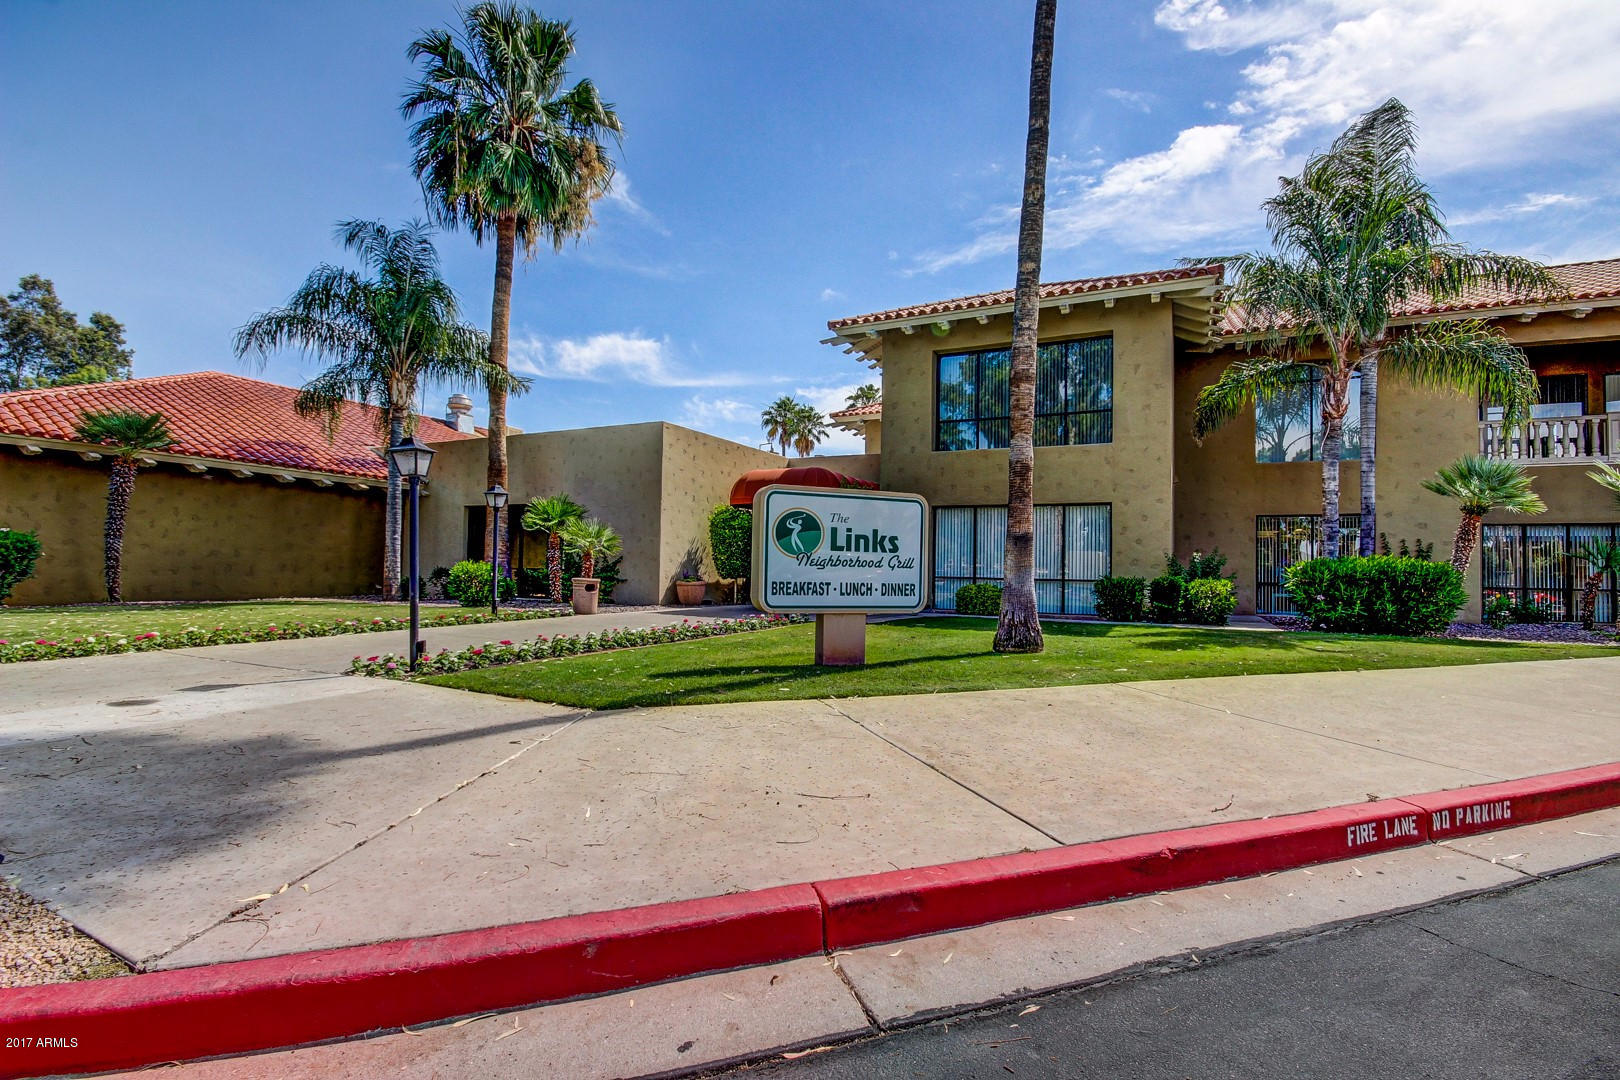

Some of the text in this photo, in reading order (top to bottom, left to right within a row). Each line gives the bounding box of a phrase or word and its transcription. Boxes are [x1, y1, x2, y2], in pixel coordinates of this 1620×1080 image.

[830, 512, 850, 524] The
[830, 526, 900, 554] Links
[796, 552, 915, 571] Neighborhood Grill
[771, 581, 916, 597] BREAKFAST LUNCH DINNER
[1347, 800, 1512, 847] FIRE LANE NO PARKING
